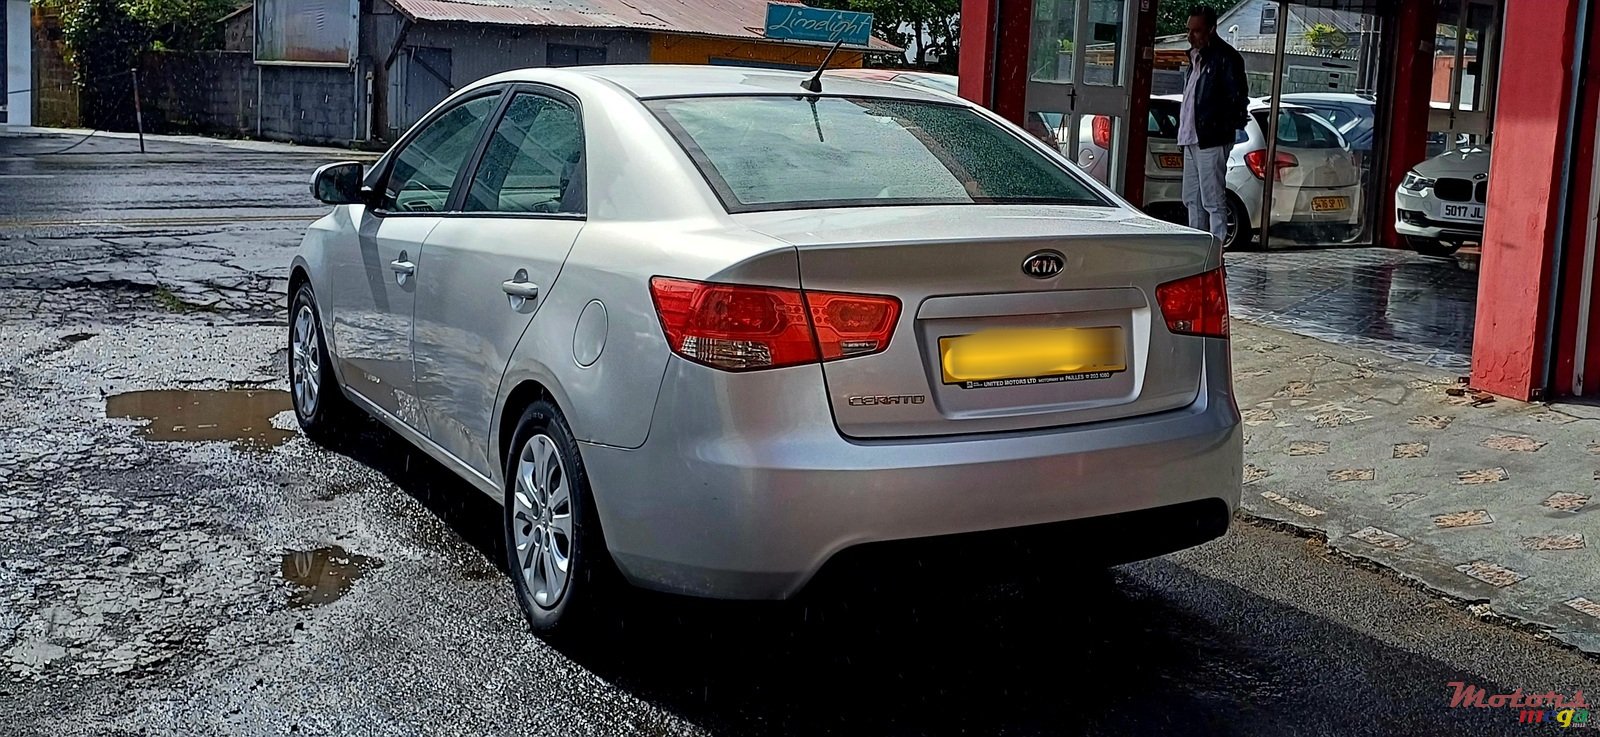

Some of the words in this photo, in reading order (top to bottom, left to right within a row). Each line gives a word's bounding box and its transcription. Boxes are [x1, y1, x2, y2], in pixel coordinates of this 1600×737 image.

[769, 7, 871, 41] Limelight
[1445, 204, 1468, 217] 5017
[1470, 207, 1484, 219] JL
[1030, 259, 1058, 273] KIA
[983, 380, 1003, 388] UNITED
[1004, 378, 1026, 386] MOTORS
[848, 394, 925, 406] CERATO
